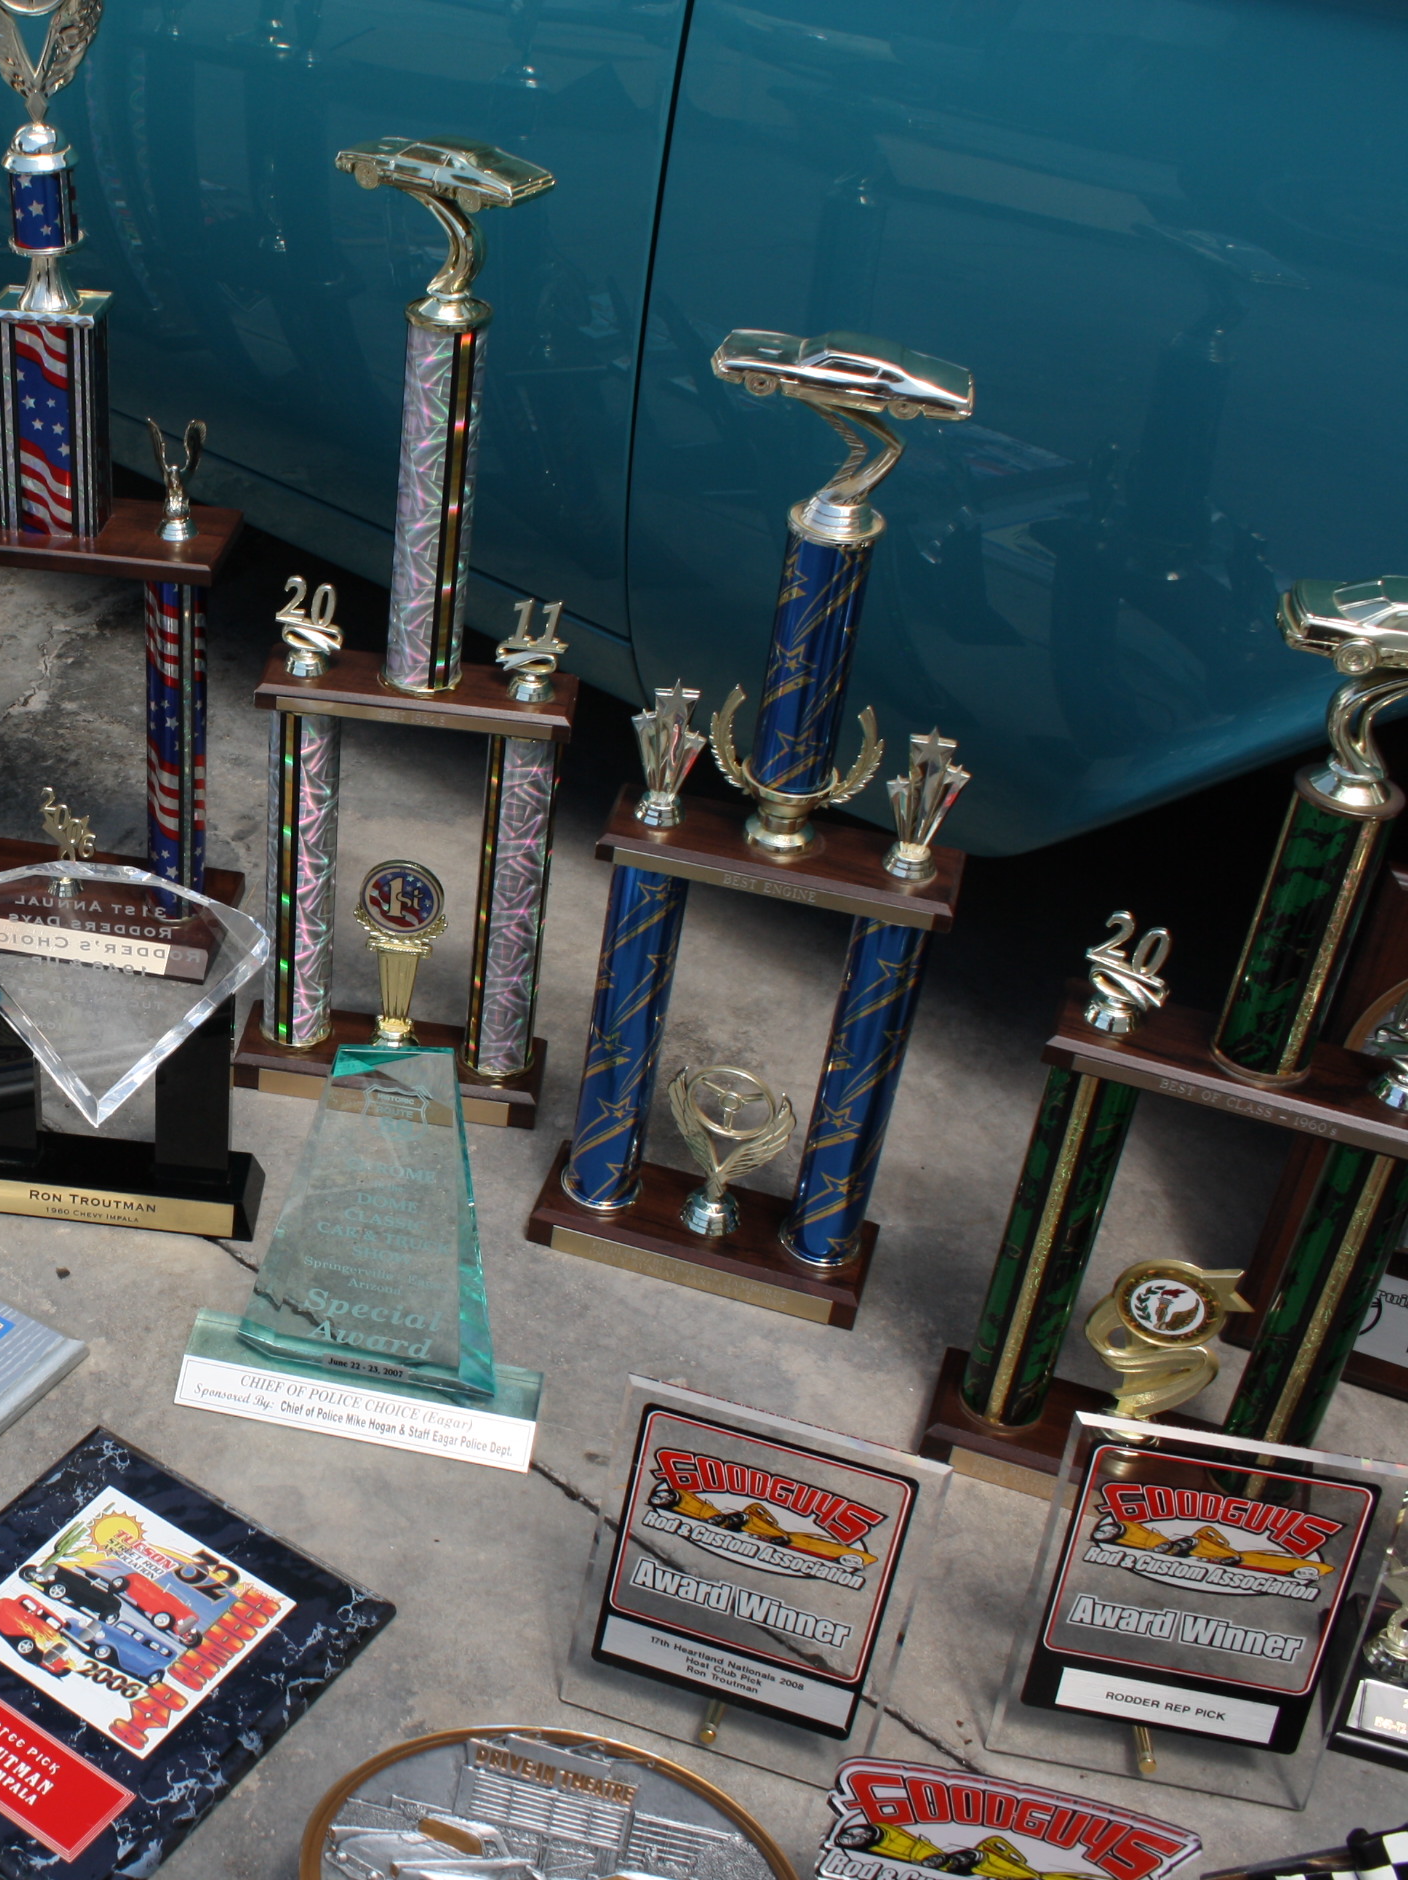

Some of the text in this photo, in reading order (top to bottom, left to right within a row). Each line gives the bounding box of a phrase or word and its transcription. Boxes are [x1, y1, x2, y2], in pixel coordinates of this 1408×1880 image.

[275, 575, 337, 627] 20
[723, 873, 818, 903] BEST ENGINE
[1086, 910, 1170, 978] 20
[1160, 1078, 1272, 1119] BEST OF CLASS
[29, 1189, 156, 1213] RON TROUTMAN
[45, 1207, 139, 1223] 1960 CHEVY IMPALA
[357, 1192, 417, 1214] DOME
[317, 1221, 377, 1242] CAR &
[304, 1287, 443, 1333] Special
[311, 1319, 433, 1360] Award
[328, 1357, 405, 1378] June 22 23, 2007
[194, 1382, 513, 1458] Sponsored By: Chief of Police Mike Hogan & Staff Eagar Police Dept.
[240, 1374, 474, 1432] CHIEF OF POLICE CHOICE (Eagar)
[650, 1448, 888, 1545] GOODGUYS
[1094, 1482, 1346, 1558] GOODGUYS
[112, 1529, 176, 1570] TUCSON
[140, 1558, 166, 1575] ROD
[642, 1511, 866, 1591] Rod & Custom Association
[173, 1549, 242, 1602] 32
[1083, 1547, 1320, 1601] Rod & Custom Association
[631, 1558, 853, 1647] Award Winner
[1067, 1594, 1306, 1662] Award Winner
[78, 1659, 146, 1700] 2006
[650, 1635, 805, 1691] 17th Heartland Nationals 2008
[685, 1656, 762, 1687] Host Club Pick
[686, 1665, 759, 1694] Ron Troutman
[1105, 1691, 1227, 1721] RODDER REP PICK
[27, 1744, 62, 1775] PICK
[475, 1745, 636, 1805] DRIVE-IN THEATRE
[844, 1772, 1189, 1880] GOODGUYS
[826, 1853, 881, 1880] Rod
